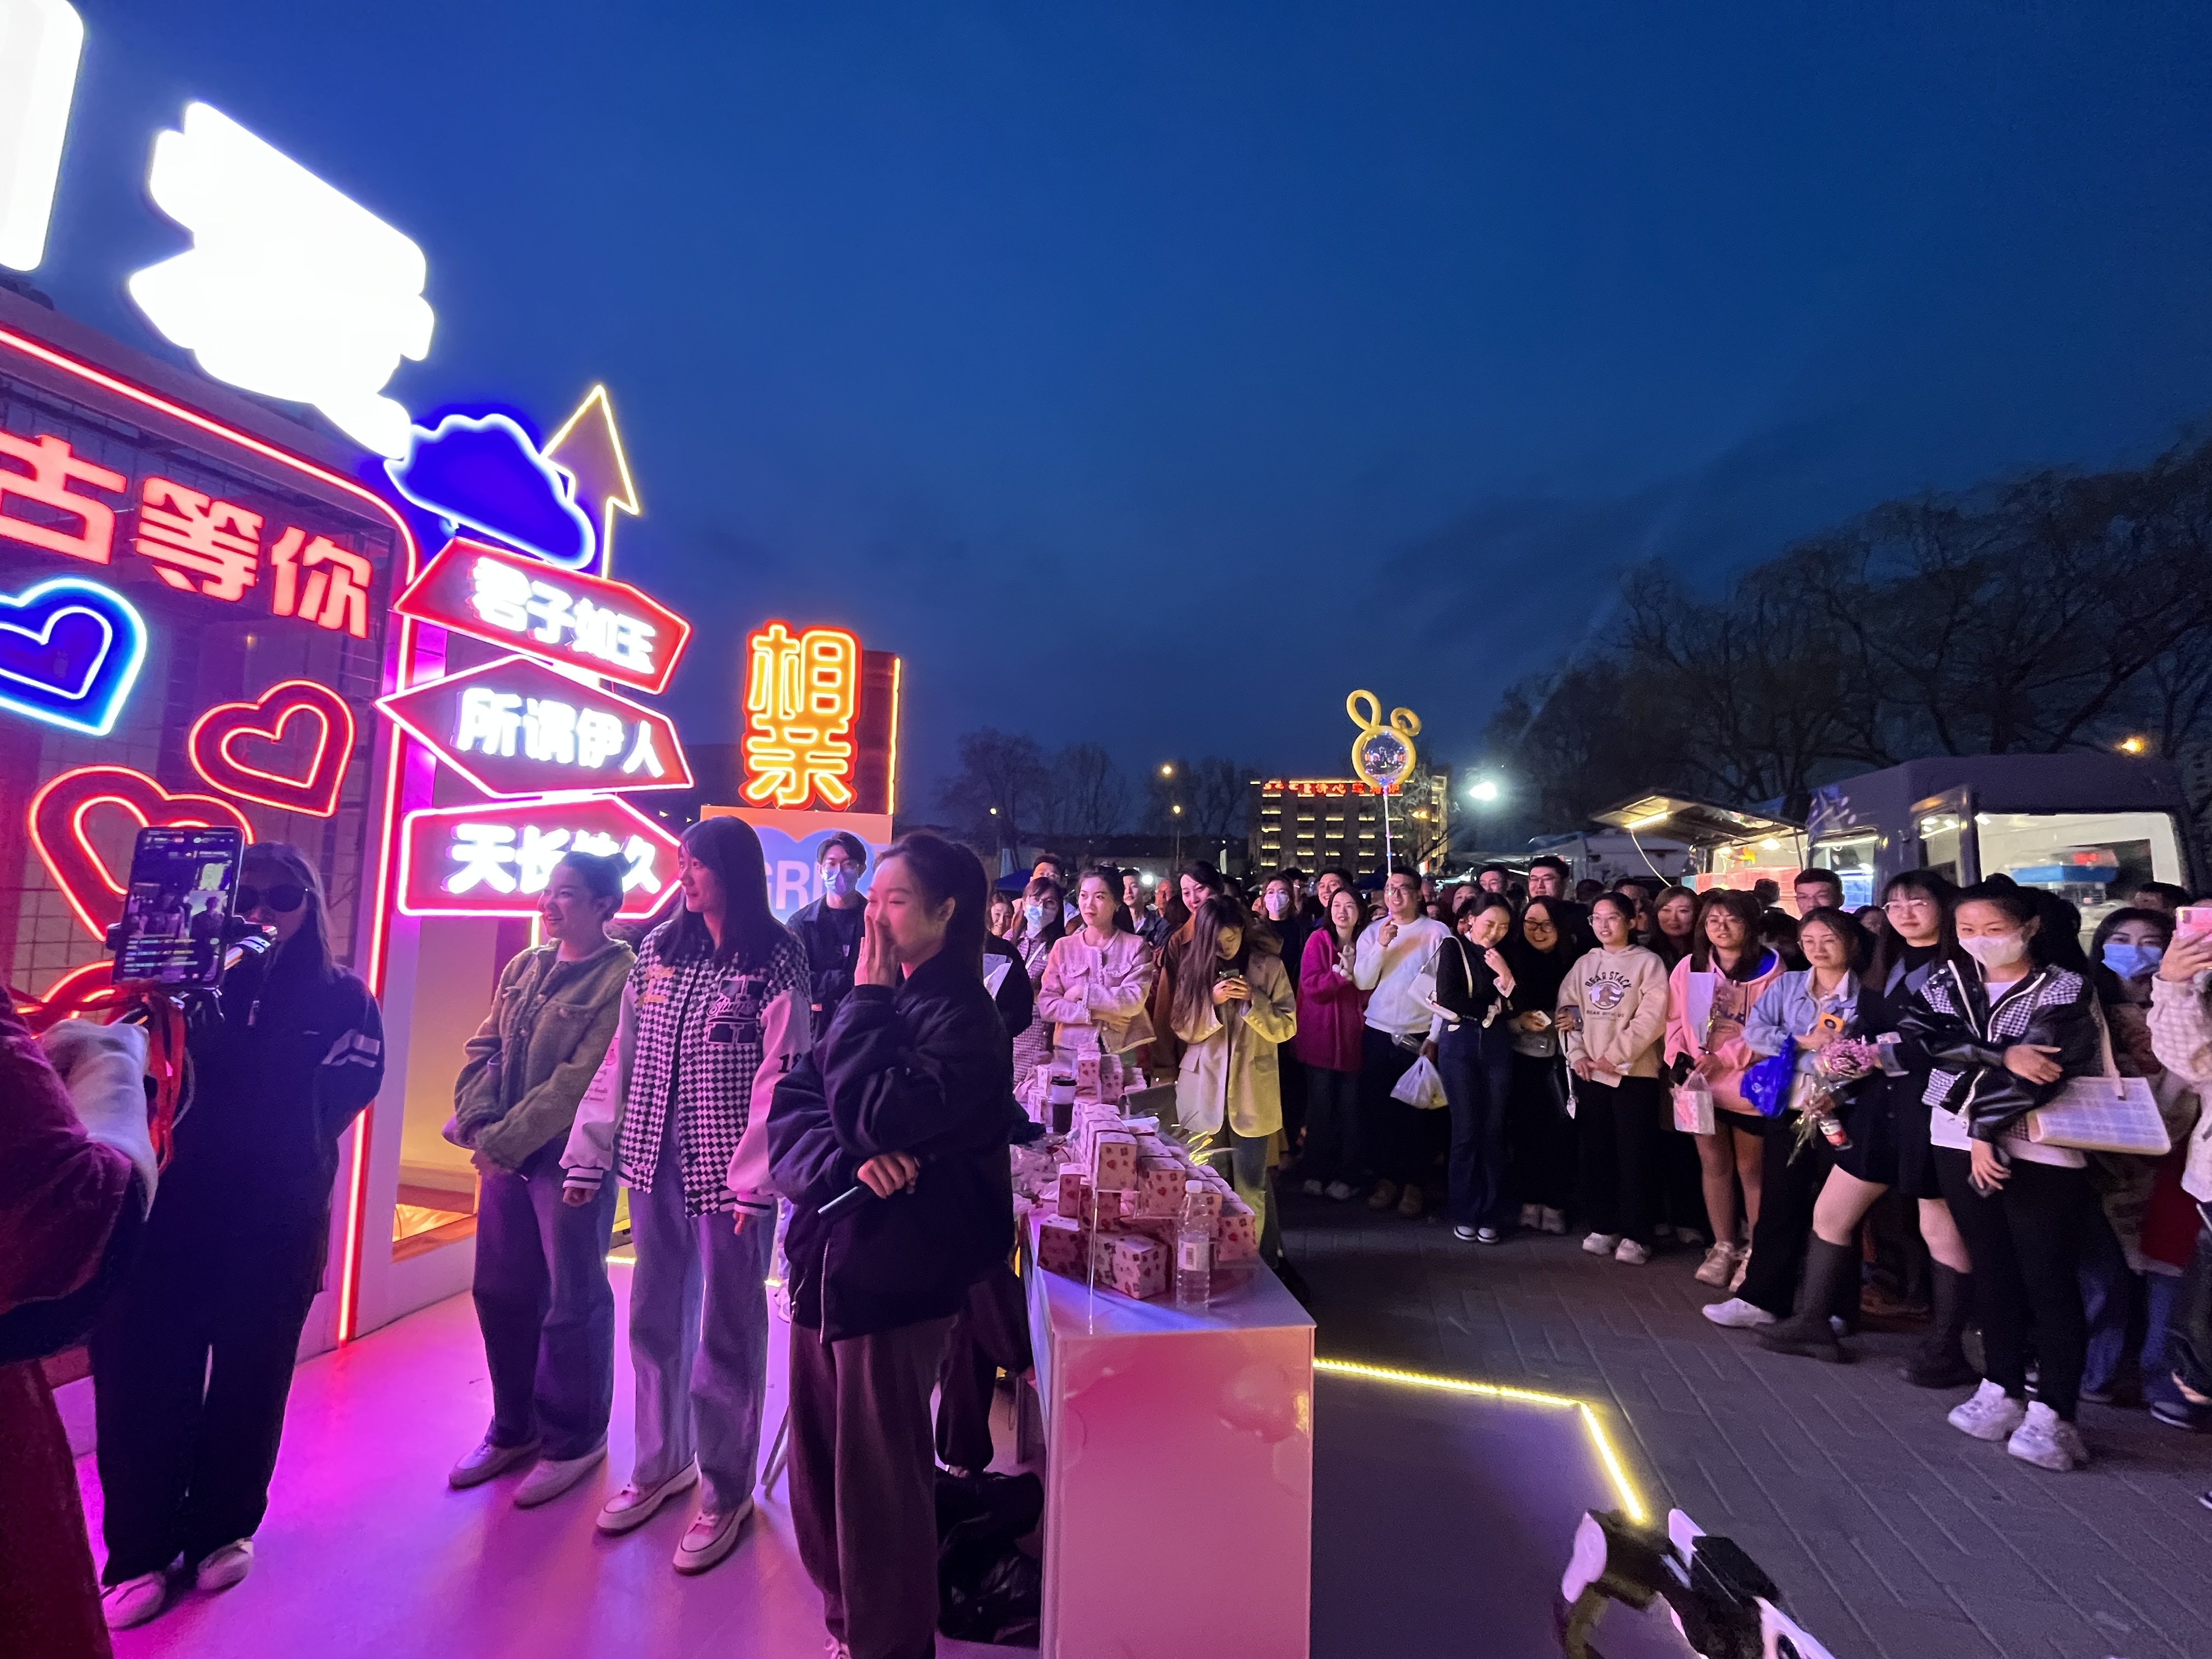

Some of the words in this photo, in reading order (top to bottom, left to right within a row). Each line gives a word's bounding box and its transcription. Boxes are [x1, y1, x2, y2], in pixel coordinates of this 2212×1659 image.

[0, 431, 373, 639] 古等你
[467, 556, 657, 674] 君子如玉
[455, 687, 665, 778] 所谓伊人
[741, 620, 860, 809] 相亲
[1585, 972, 1606, 987] BEAR
[1609, 971, 1632, 989] STACK
